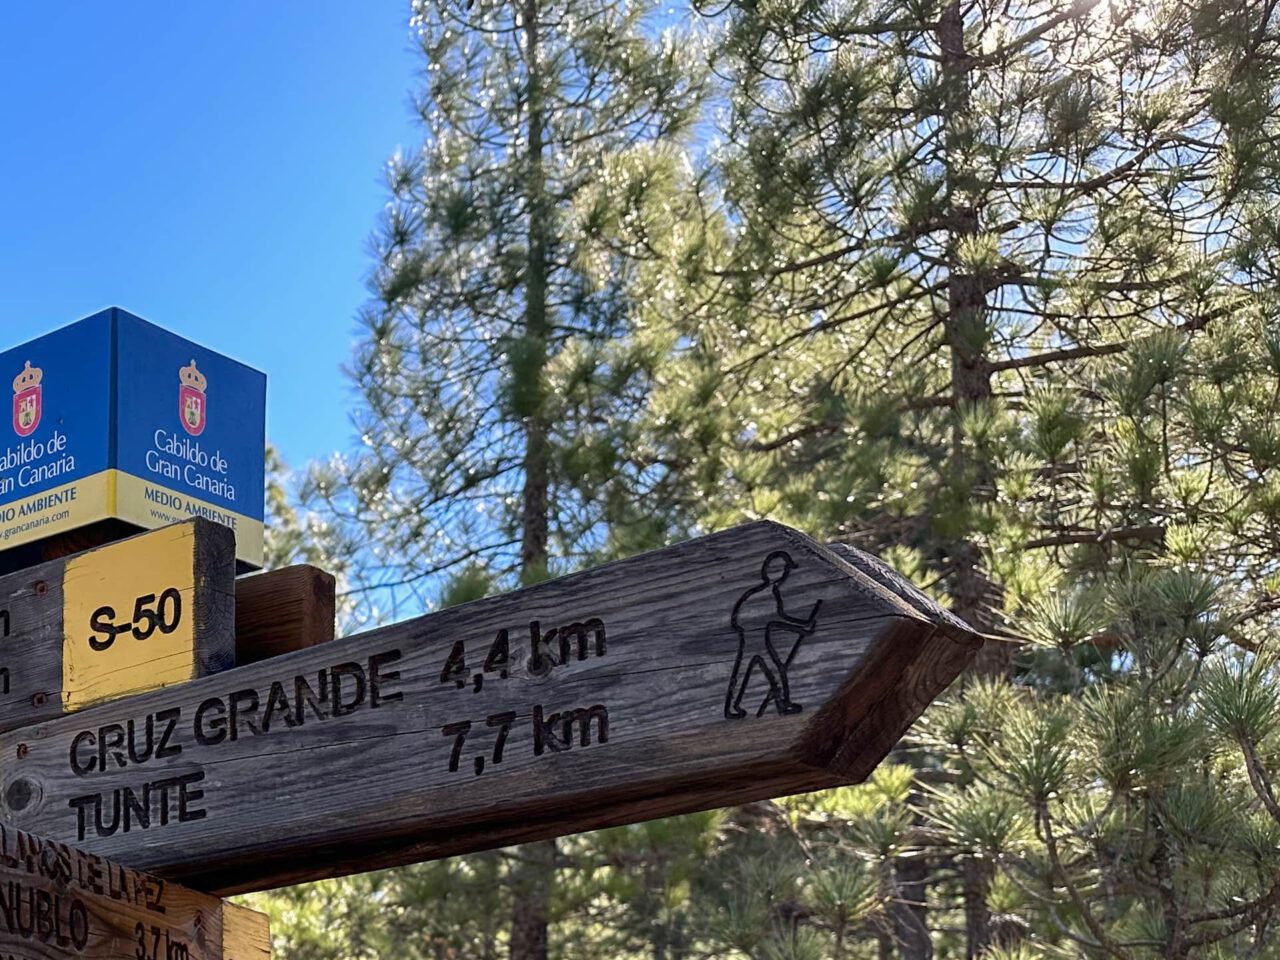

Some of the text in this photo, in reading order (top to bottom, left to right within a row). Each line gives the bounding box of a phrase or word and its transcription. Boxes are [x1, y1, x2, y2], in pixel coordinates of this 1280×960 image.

[47, 430, 67, 455] de
[154, 429, 228, 475] Cabildo de
[18, 452, 75, 488] Canaria
[145, 450, 235, 501] Gran Canaria
[18, 487, 77, 518] AMBIENTE
[144, 487, 182, 511] MEDIO
[88, 587, 182, 652] S-50
[70, 617, 608, 777] CRUZ GRANDE 4,4 km
[68, 703, 609, 842] TUNTE 7,7 km
